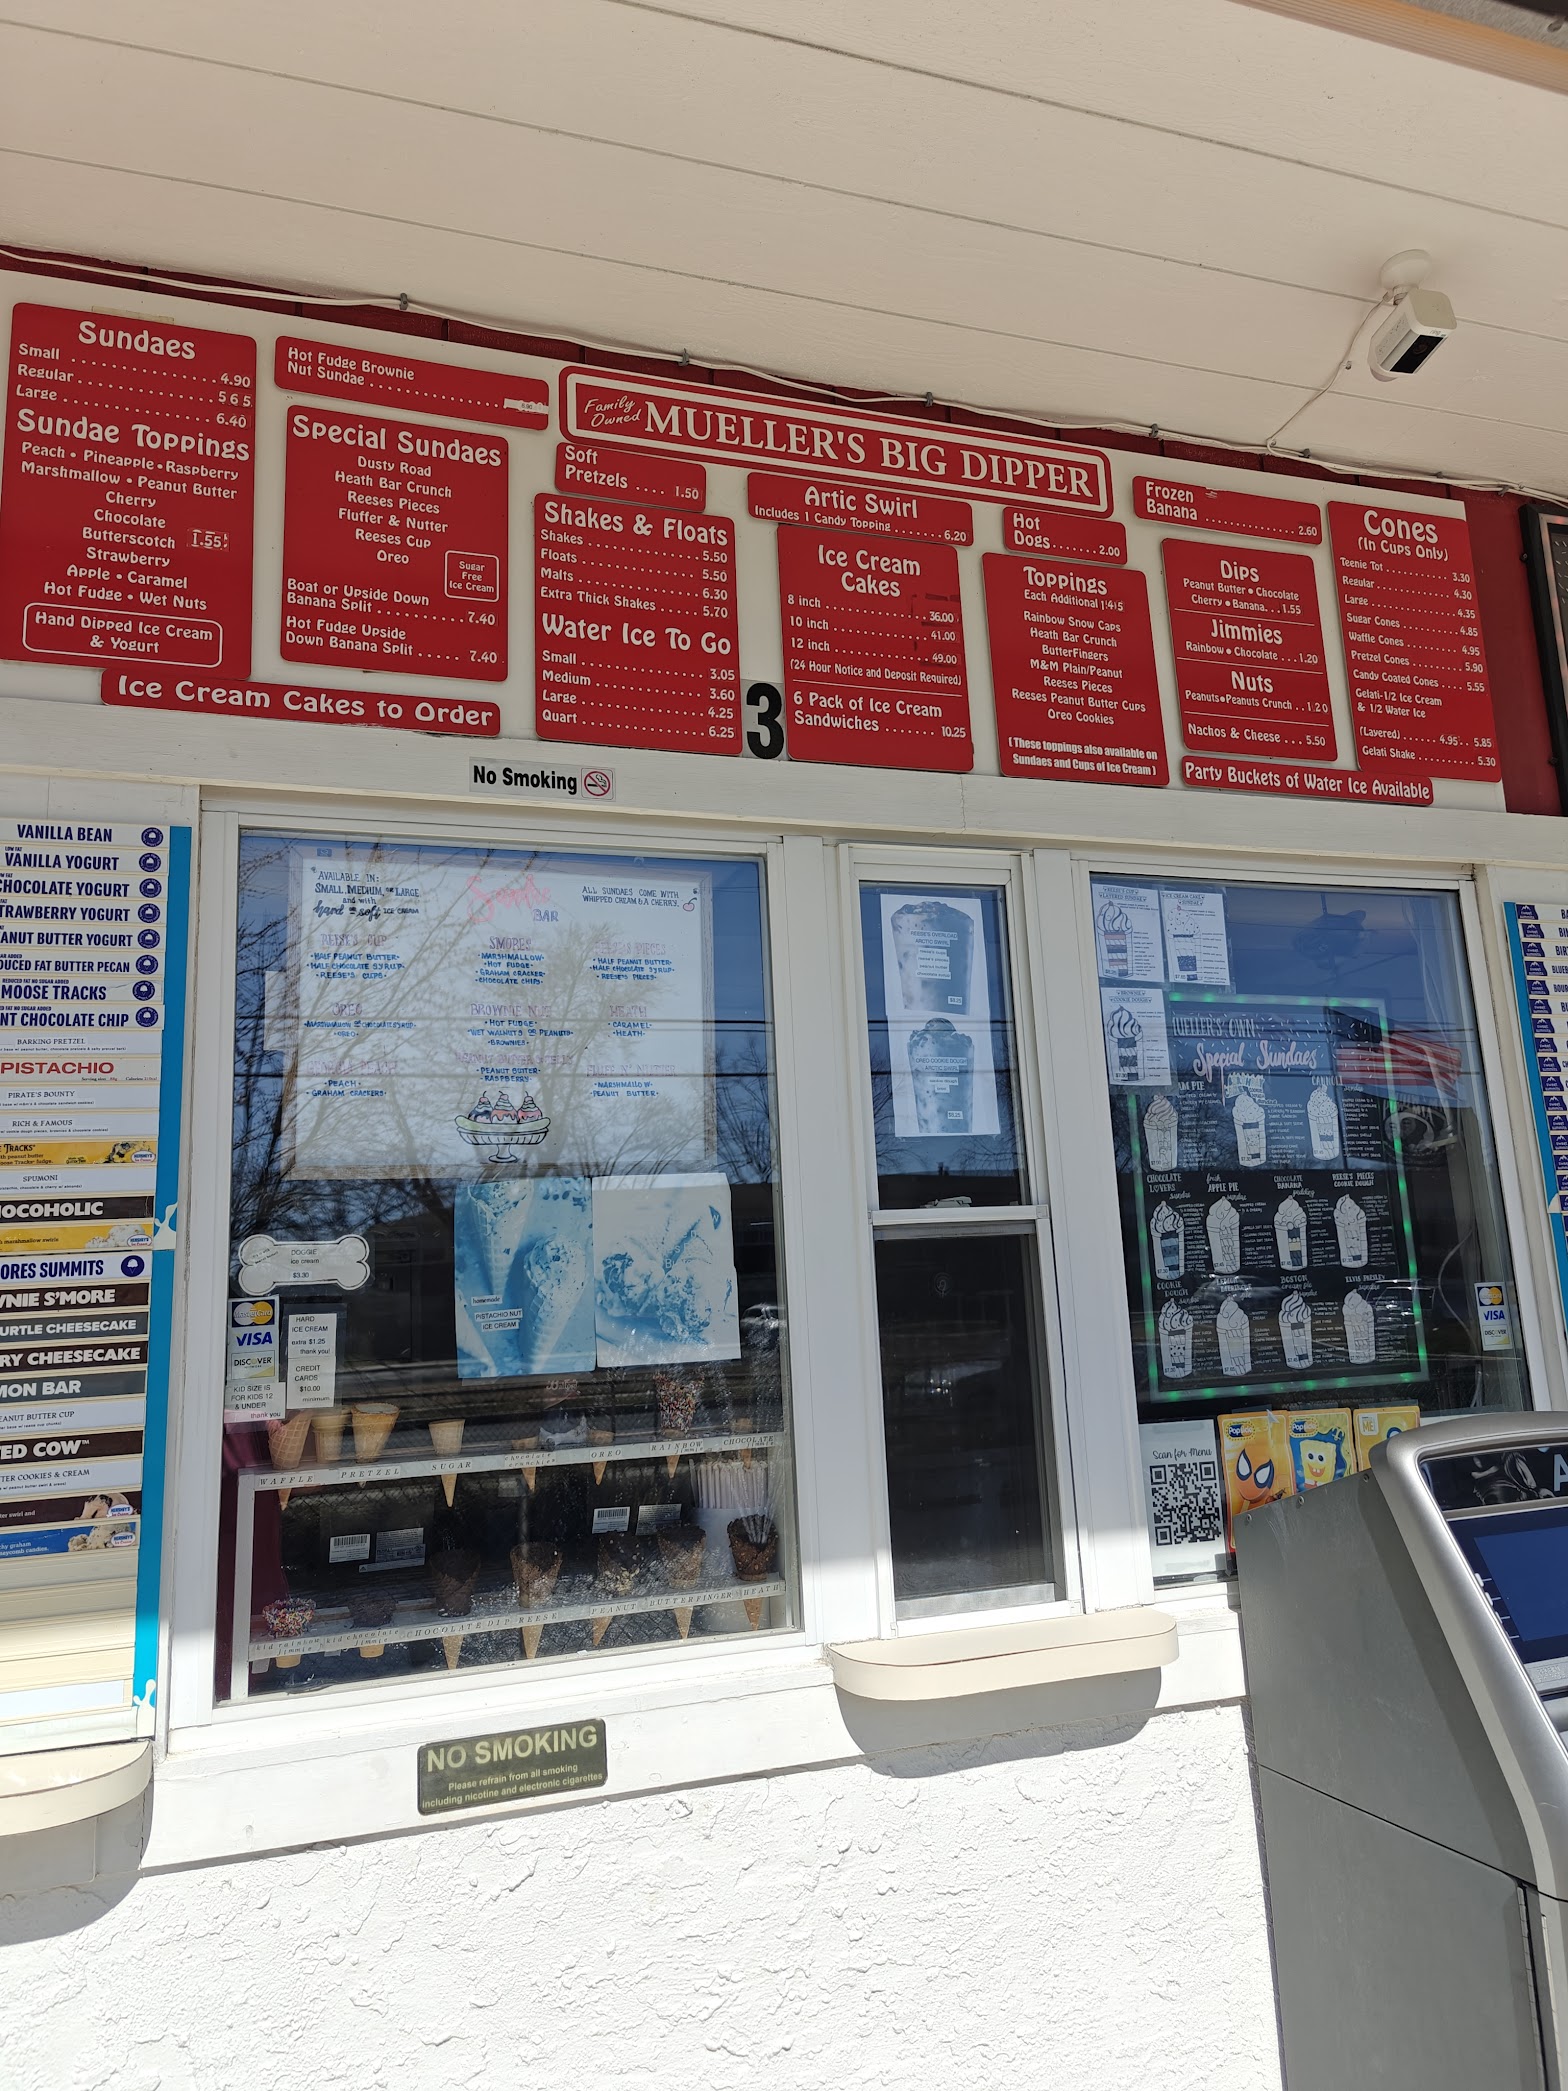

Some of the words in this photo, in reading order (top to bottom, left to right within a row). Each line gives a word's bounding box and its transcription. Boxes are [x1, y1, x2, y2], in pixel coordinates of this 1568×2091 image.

[78, 320, 195, 360] Sundaes
[18, 344, 60, 360] Small
[220, 373, 250, 388] 4.90
[16, 385, 57, 400] Large
[216, 413, 247, 428] 6.40
[584, 395, 636, 414] Family
[591, 409, 642, 427] Owned
[17, 409, 120, 444] Sundae
[131, 424, 250, 461] Toppings
[293, 414, 386, 450] Special
[398, 431, 502, 467] Sundaes
[21, 442, 65, 458] Peach
[84, 450, 154, 470] Pineapple
[166, 461, 239, 480] Raspberry
[565, 445, 598, 465] Soft
[645, 401, 867, 464] MUELLER'S
[880, 437, 948, 476] BIG
[959, 448, 1094, 499] DIPPER
[21, 461, 120, 484] Marshmallow
[138, 476, 187, 493] Peanut
[193, 484, 237, 499] Butter
[565, 464, 628, 489] Pretzels
[675, 485, 699, 500] 1.50
[1146, 481, 1194, 503] Frozen
[106, 491, 156, 508] Cherry
[805, 486, 857, 511] Artic
[865, 493, 918, 518] Swirl
[94, 509, 166, 528] Chocolate
[544, 502, 624, 532] Shakes
[633, 514, 653, 536] &
[663, 518, 728, 546] Floats
[1013, 513, 1040, 530] Hot
[1146, 499, 1197, 520] Banana
[1298, 526, 1317, 536] 2.60
[1363, 510, 1438, 544] Cones
[82, 527, 176, 549] Butterscotch
[1014, 530, 1050, 549] Dogs
[1099, 545, 1120, 557] 2.00
[1358, 536, 1376, 551] (In
[1381, 540, 1411, 557] Cups
[1415, 545, 1448, 561] Only)
[86, 547, 170, 567] Strawberry
[818, 545, 848, 567] Ice
[856, 550, 921, 576] Cream
[841, 571, 901, 597] Cakes
[1023, 565, 1108, 595] Toppings
[1220, 560, 1259, 582] Dips
[542, 613, 612, 642] Water
[623, 623, 656, 647] Ice
[665, 627, 691, 650] To
[701, 631, 731, 655] Go
[1211, 619, 1283, 645] Jimmies
[1042, 645, 1109, 662] ButterFingers
[1231, 671, 1273, 693] Nuts
[119, 675, 162, 699] Ice
[175, 681, 271, 708] Cream
[283, 691, 365, 716] Cakes
[377, 701, 403, 719] to
[415, 702, 493, 726] Order
[794, 691, 803, 705] 6
[809, 692, 842, 709] Pack
[849, 697, 864, 711] of
[870, 698, 891, 714] Ice
[896, 701, 942, 717] Cream
[746, 683, 784, 760] 3
[794, 711, 879, 732] Sandwiches
[941, 726, 966, 738] 10.25
[1048, 709, 1072, 721] Oreo
[1076, 712, 1114, 725] Cookies
[1188, 723, 1226, 738] Nachos
[1230, 727, 1239, 739] &
[1244, 729, 1280, 743] Cheese
[1306, 735, 1326, 746] 5.50
[473, 765, 496, 785] No
[502, 767, 577, 795] Smoking
[1185, 762, 1222, 781] Party
[1228, 766, 1281, 787] Buckets
[1286, 773, 1299, 788] of
[1304, 773, 1342, 792] Water
[1348, 777, 1368, 795] Ice
[1372, 780, 1430, 800] Available
[17, 824, 73, 841] VANILLA
[77, 826, 112, 842] BEAN
[5, 853, 62, 868] VANILLA
[65, 855, 119, 870] YOGURT
[318, 871, 360, 882] AVAILABLE
[582, 886, 597, 894] ALL
[1, 985, 49, 999] MOOSE
[52, 985, 107, 1000] TRACKS
[1, 1062, 114, 1074] PISTACHIO
[1193, 1042, 1246, 1083] Special
[1257, 1040, 1317, 1070] Sundaes
[8, 1091, 42, 1099] PIRATE'S
[1208, 1183, 1227, 1192] APPLE
[1228, 1182, 1239, 1192] PIE
[46, 1320, 136, 1333] CHEESECAKE
[1484, 1311, 1505, 1321] VISA
[236, 1332, 272, 1346] VISA
[27, 1348, 140, 1365] CHEESECAKE
[1153, 1450, 1172, 1460] Scan
[1174, 1449, 1186, 1461] for
[1189, 1449, 1212, 1458] Menu
[259, 1474, 315, 1487] WAFFLE
[340, 1466, 401, 1479] PRETZEL
[431, 1461, 472, 1471] SUGAR
[427, 1745, 466, 1772] NO
[475, 1725, 598, 1764] SMOKING
[422, 1795, 462, 1808] including
[465, 1789, 499, 1802] nicotine
[501, 1785, 517, 1795] and
[519, 1779, 560, 1793] electronic
[562, 1773, 603, 1787] cigarettes
[449, 1780, 477, 1791] Please
[479, 1775, 507, 1787] refrain
[509, 1772, 528, 1782] from
[530, 1770, 540, 1778] all
[542, 1764, 578, 1778] smoking
